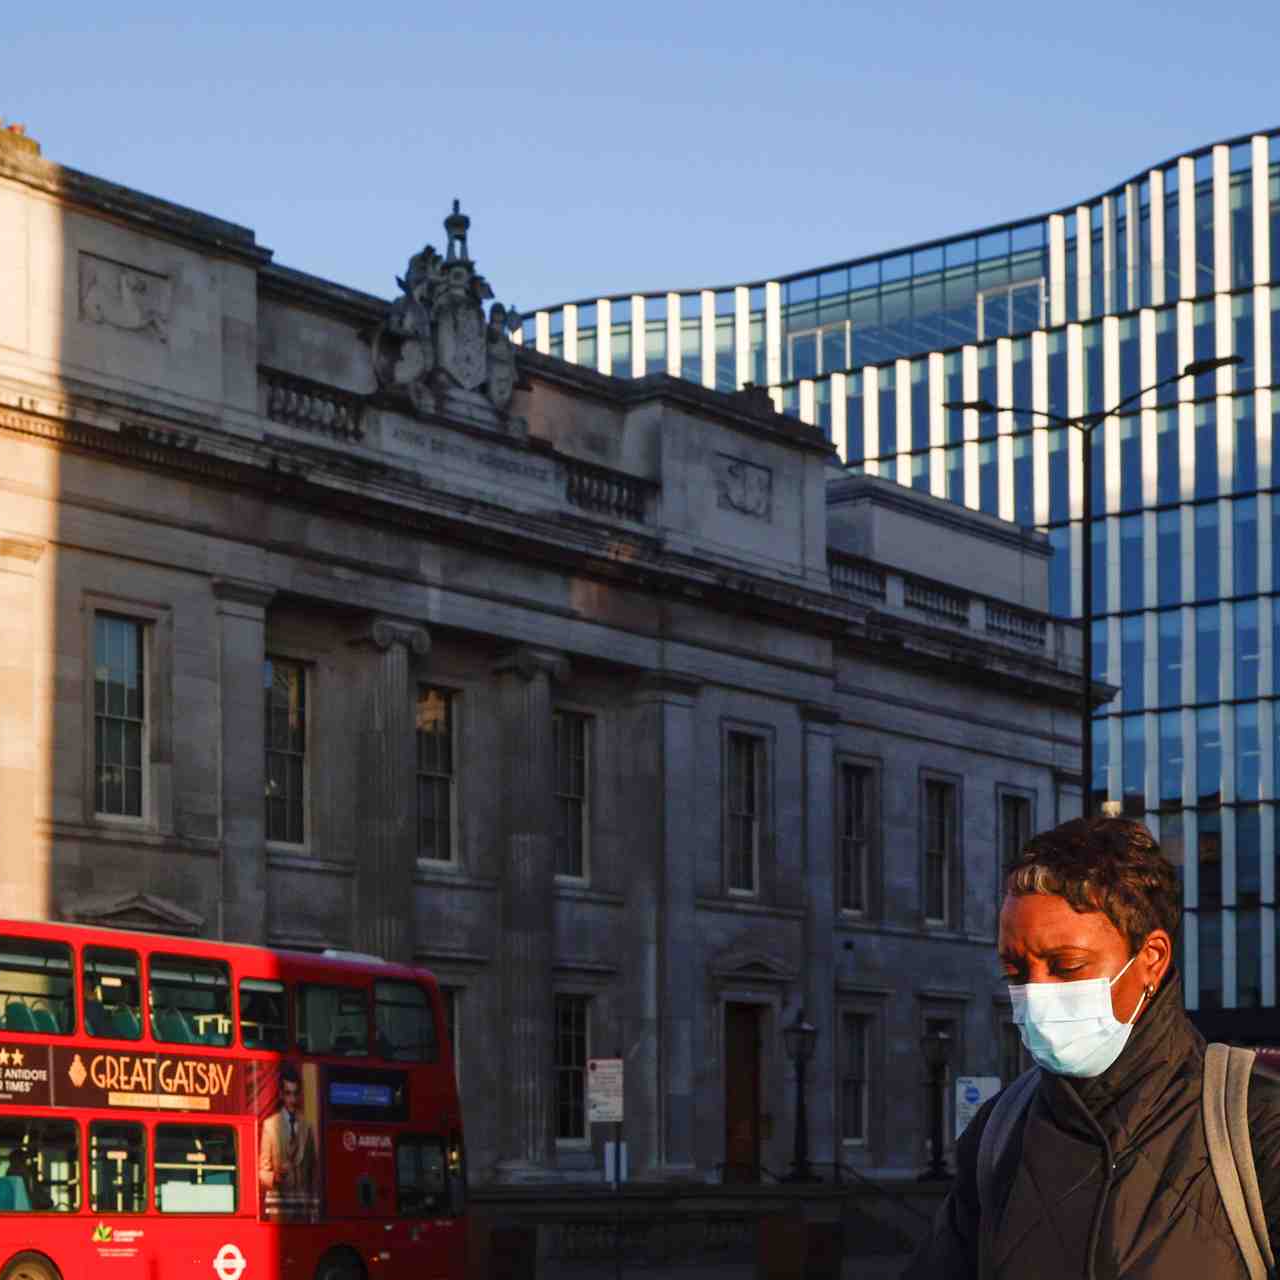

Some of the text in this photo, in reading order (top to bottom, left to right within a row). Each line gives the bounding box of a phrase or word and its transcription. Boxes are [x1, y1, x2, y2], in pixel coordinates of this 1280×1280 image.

[4, 1068, 48, 1082] ANTIDOTE
[89, 1054, 157, 1091] GREAT
[157, 1058, 233, 1096] GATSBY
